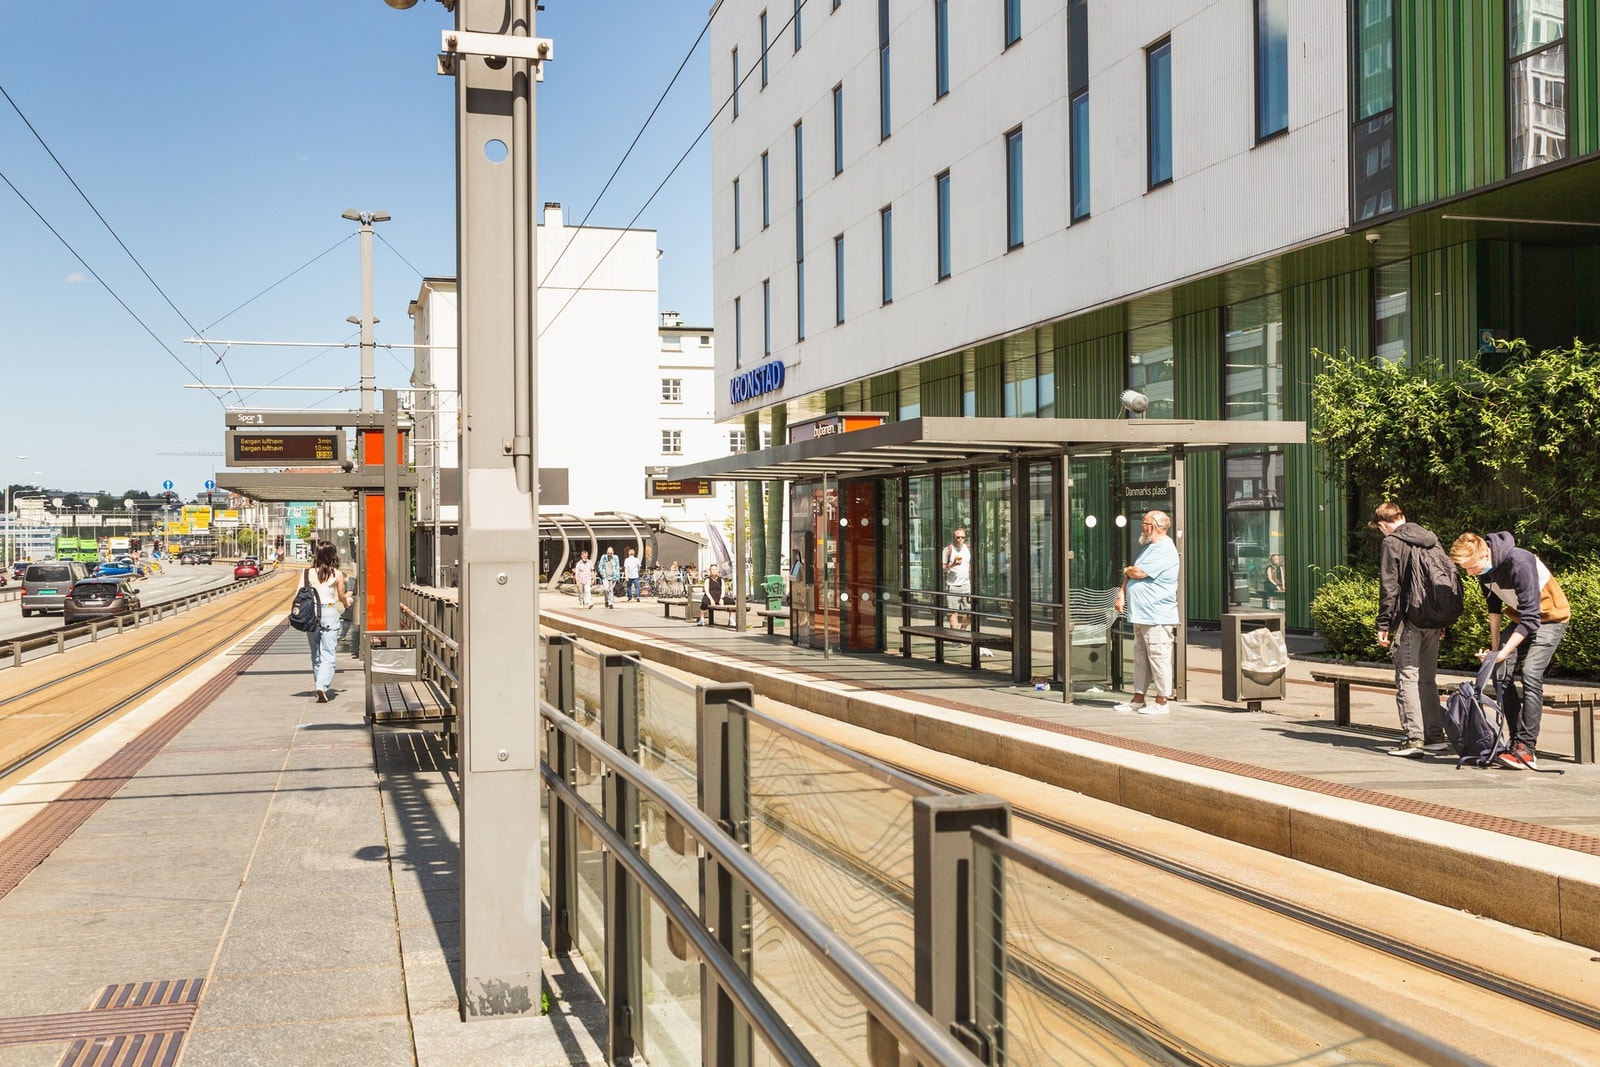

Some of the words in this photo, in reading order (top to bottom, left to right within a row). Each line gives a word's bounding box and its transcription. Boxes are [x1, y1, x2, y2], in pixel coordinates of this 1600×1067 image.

[730, 360, 785, 404] KRONSTAD
[238, 414, 255, 422] Spor
[256, 414, 264, 424] 1
[1125, 486, 1151, 496] Danmarks
[1152, 485, 1167, 498] plass
